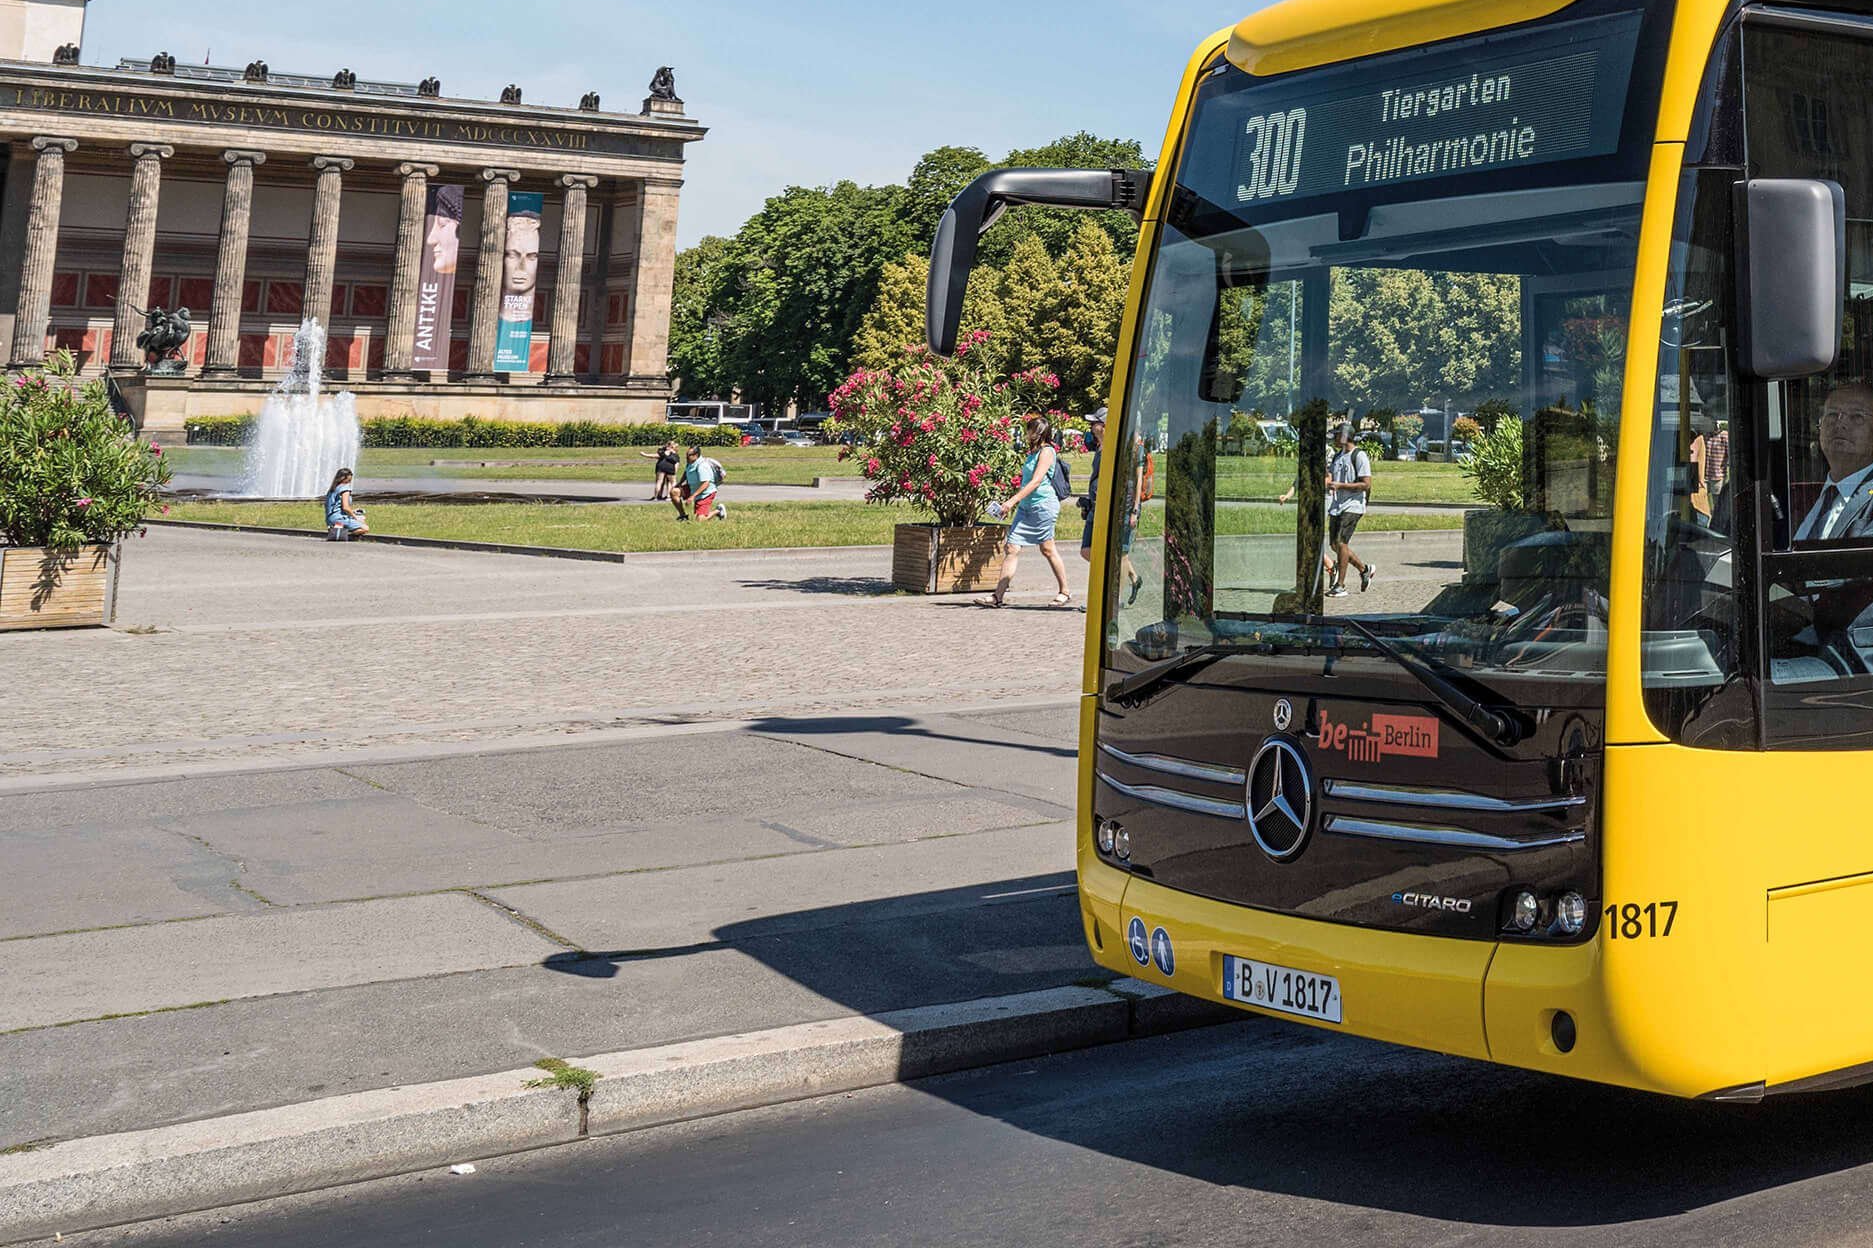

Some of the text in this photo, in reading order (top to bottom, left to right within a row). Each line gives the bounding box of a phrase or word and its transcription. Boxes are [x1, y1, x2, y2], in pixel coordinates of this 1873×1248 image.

[1381, 73, 1510, 122] Tiergarten
[191, 103, 289, 126] MVSEVM
[302, 112, 445, 137] CONSTITVIT
[1236, 107, 1535, 202] 300 Philharmonie
[415, 282, 438, 351] ANTIKE
[1383, 725, 1432, 749] Berlin
[1392, 891, 1472, 913] eCITARO
[1604, 901, 1679, 940] 1817
[1241, 963, 1332, 1014] B V 1817
